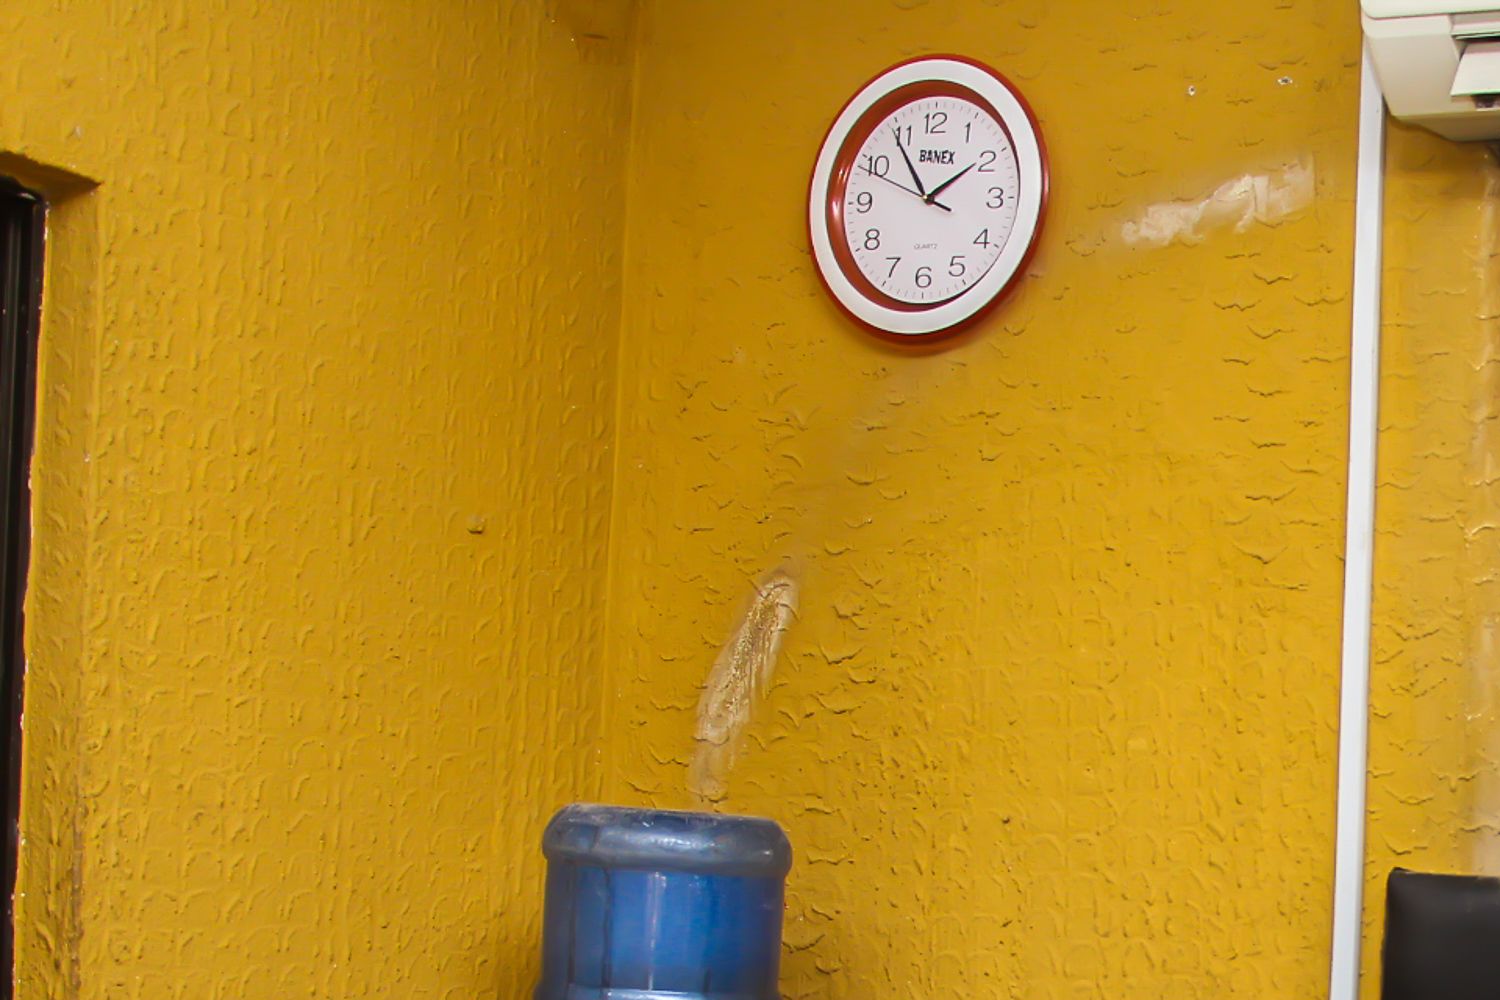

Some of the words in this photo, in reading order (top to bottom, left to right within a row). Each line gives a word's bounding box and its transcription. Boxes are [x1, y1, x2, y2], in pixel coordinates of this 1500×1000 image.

[923, 111, 947, 134] 12
[964, 122, 972, 144] 1
[895, 125, 913, 148] 11
[867, 154, 890, 177] 10
[918, 149, 955, 165] BANEX
[977, 150, 997, 173] 2
[856, 191, 873, 213] 9
[985, 187, 1005, 209] 3
[863, 228, 881, 251] 8
[972, 228, 991, 250] 4
[885, 256, 901, 279] 7
[914, 265, 932, 288] 6
[947, 255, 967, 278] 5
